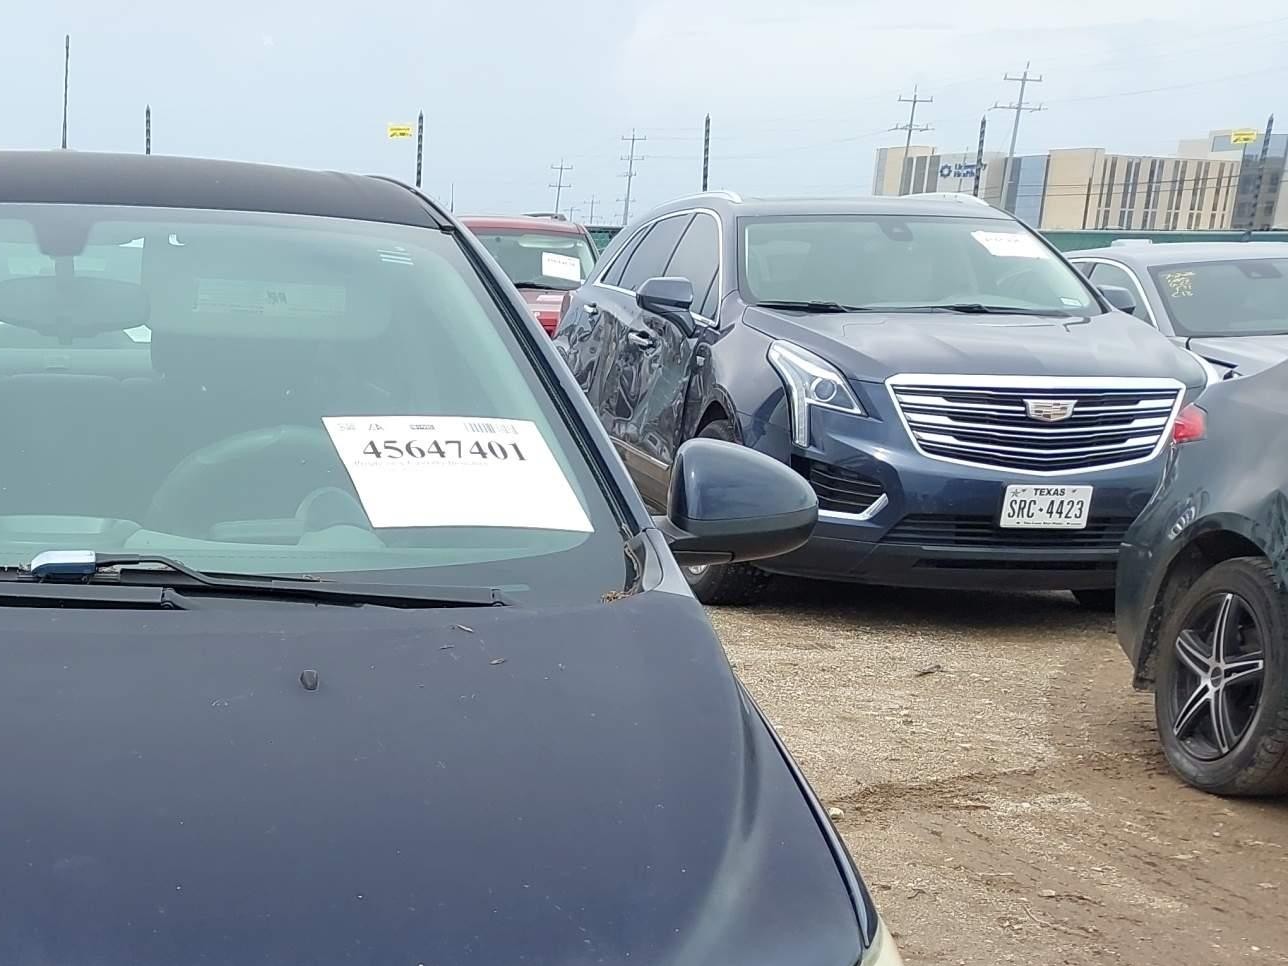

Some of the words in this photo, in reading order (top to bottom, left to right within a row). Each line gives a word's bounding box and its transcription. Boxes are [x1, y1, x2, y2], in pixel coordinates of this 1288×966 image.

[362, 439, 529, 462] 45647401
[1033, 488, 1066, 497] TEXAS
[1007, 499, 1037, 519] SRC
[1045, 499, 1084, 519] 4423
